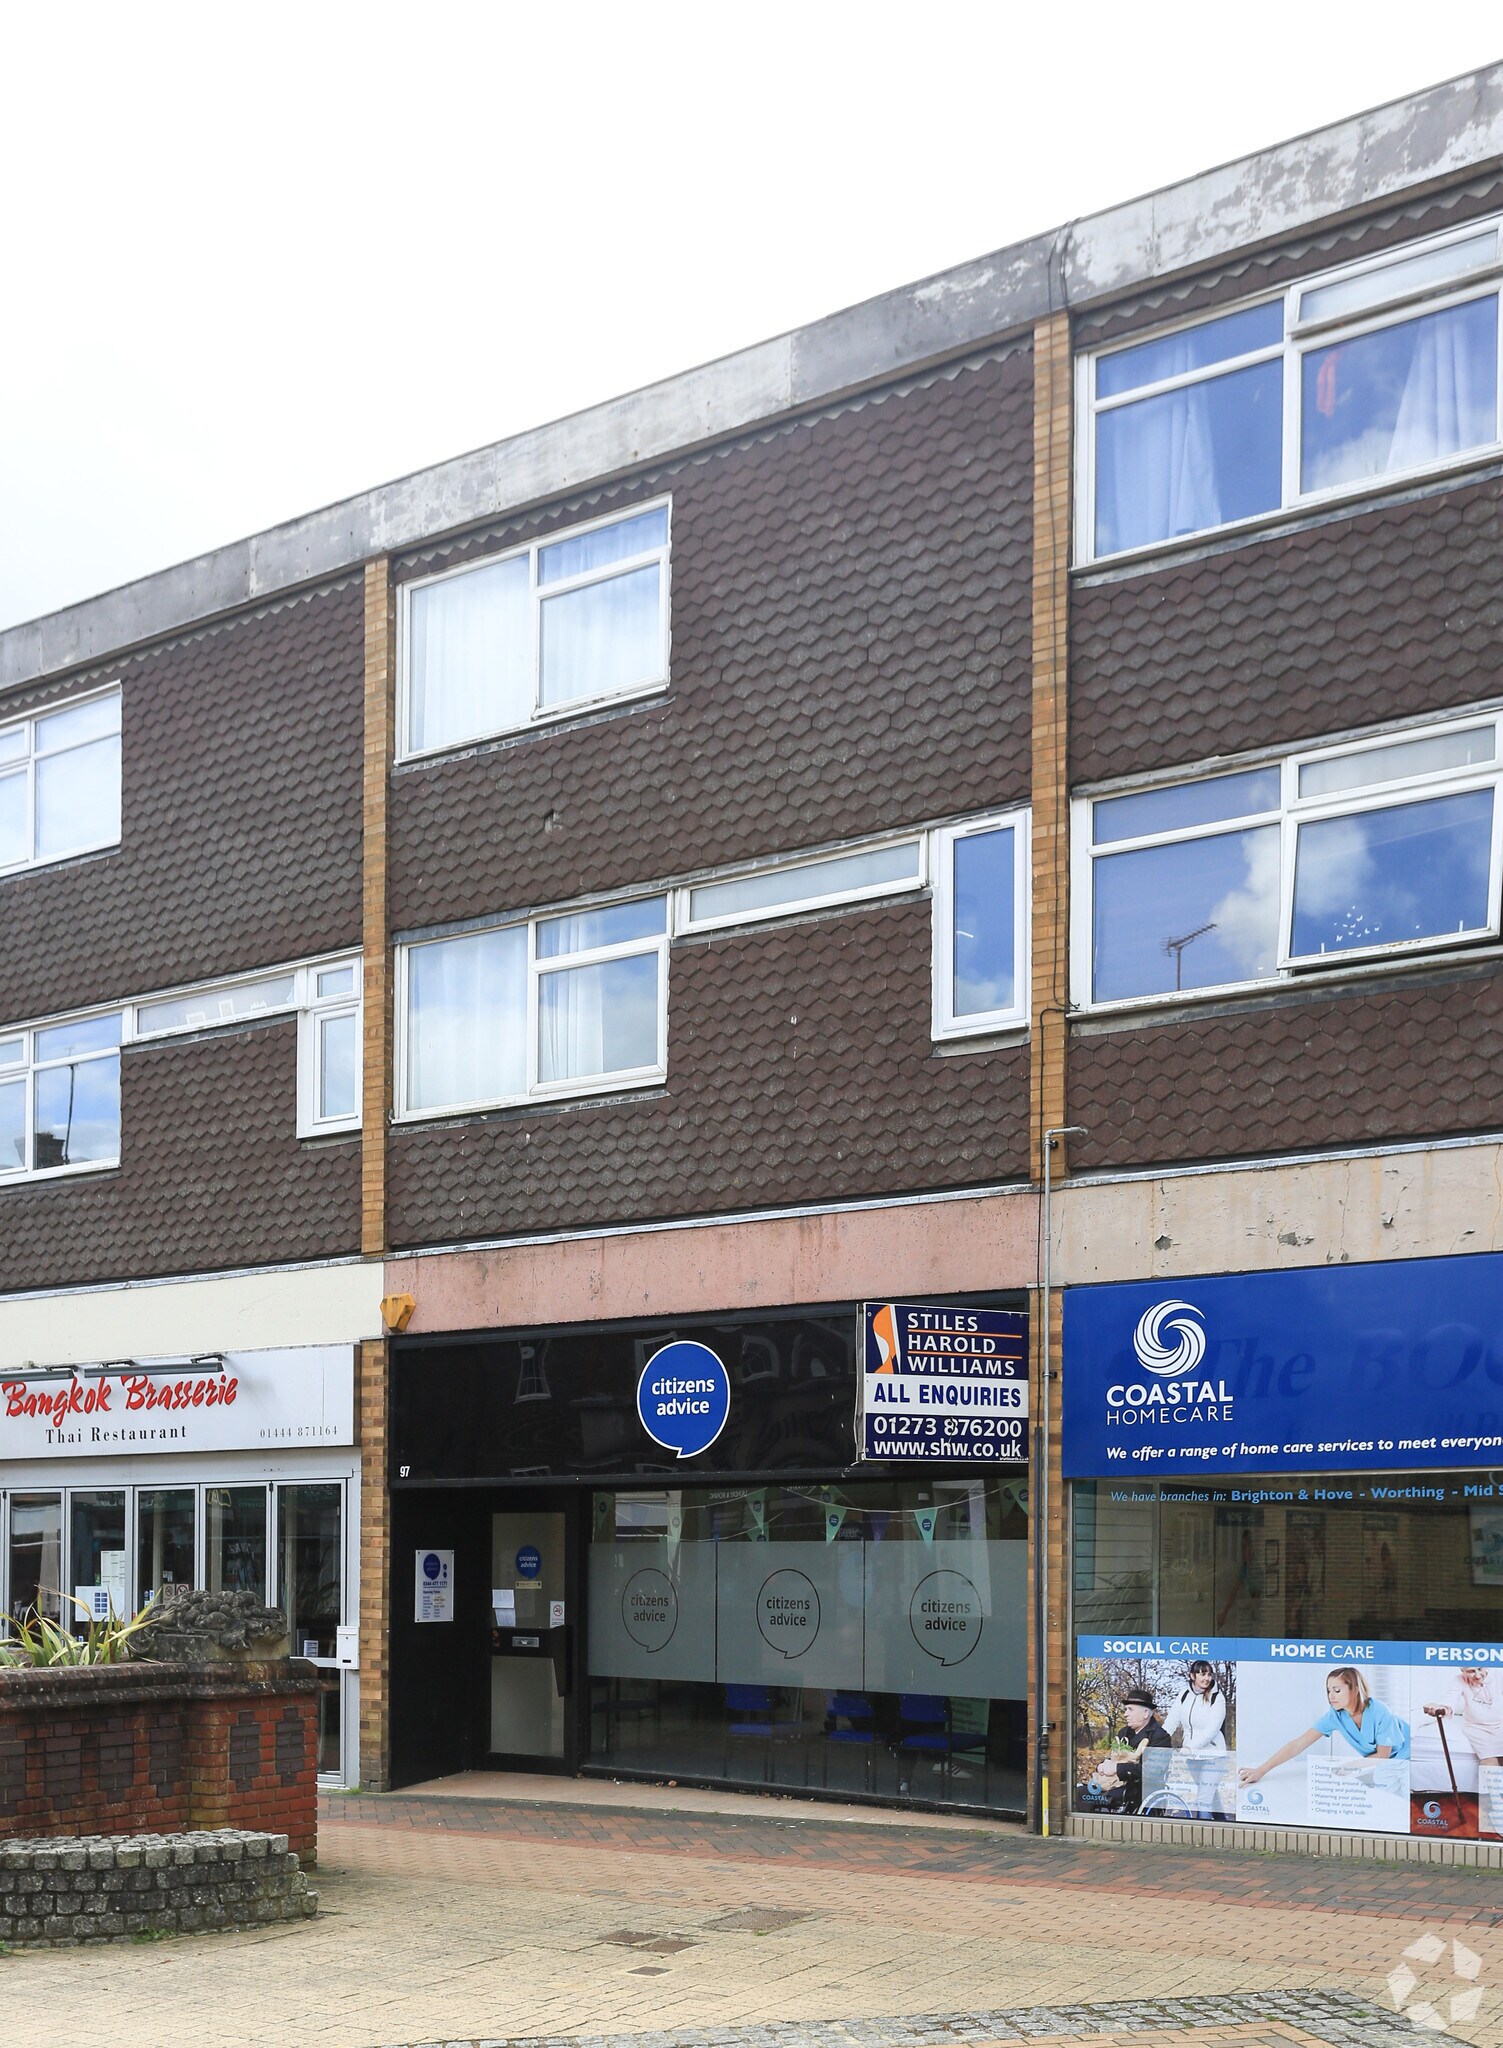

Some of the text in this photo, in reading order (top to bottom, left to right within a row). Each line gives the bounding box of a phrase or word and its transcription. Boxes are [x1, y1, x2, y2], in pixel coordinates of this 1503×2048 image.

[907, 1312, 978, 1332] STILES
[908, 1334, 996, 1354] HAROLD
[907, 1356, 1015, 1376] WILLIAMS
[652, 1377, 715, 1395] citizens
[874, 1382, 1021, 1408] ALL ENQUIRIES
[1106, 1380, 1234, 1407] COASTAL
[1, 1374, 239, 1427] Bangkok Brasserie
[656, 1398, 710, 1416] advice
[1107, 1405, 1234, 1426] HOMECARE
[46, 1425, 187, 1444] Thai Restaurant
[260, 1426, 338, 1438] 01444 871164
[874, 1416, 1022, 1438] 01273 876200
[874, 1438, 1022, 1458] www.shw.co.uk
[1106, 1436, 1503, 1461] We offer a range of home care services to meet everyon
[400, 1466, 410, 1477] 97
[1111, 1492, 1128, 1502] We
[1131, 1491, 1156, 1502] have
[1160, 1490, 1209, 1502] branches
[1213, 1491, 1226, 1501] in:
[1232, 1490, 1294, 1504] Brighton
[1298, 1490, 1308, 1500] &
[1314, 1488, 1353, 1500] Hove
[1370, 1486, 1444, 1500] Worthing
[1464, 1484, 1493, 1496] Mid
[630, 1595, 669, 1607] citizens
[766, 1597, 810, 1610] citizens
[921, 1599, 971, 1614] citizens
[634, 1610, 666, 1622] advice
[770, 1613, 806, 1626] advice
[925, 1617, 966, 1631] advice
[1104, 1640, 1209, 1655] SOCIAL CARE
[1270, 1644, 1374, 1658] HOME CARE
[1426, 1647, 1503, 1662] PERSON
